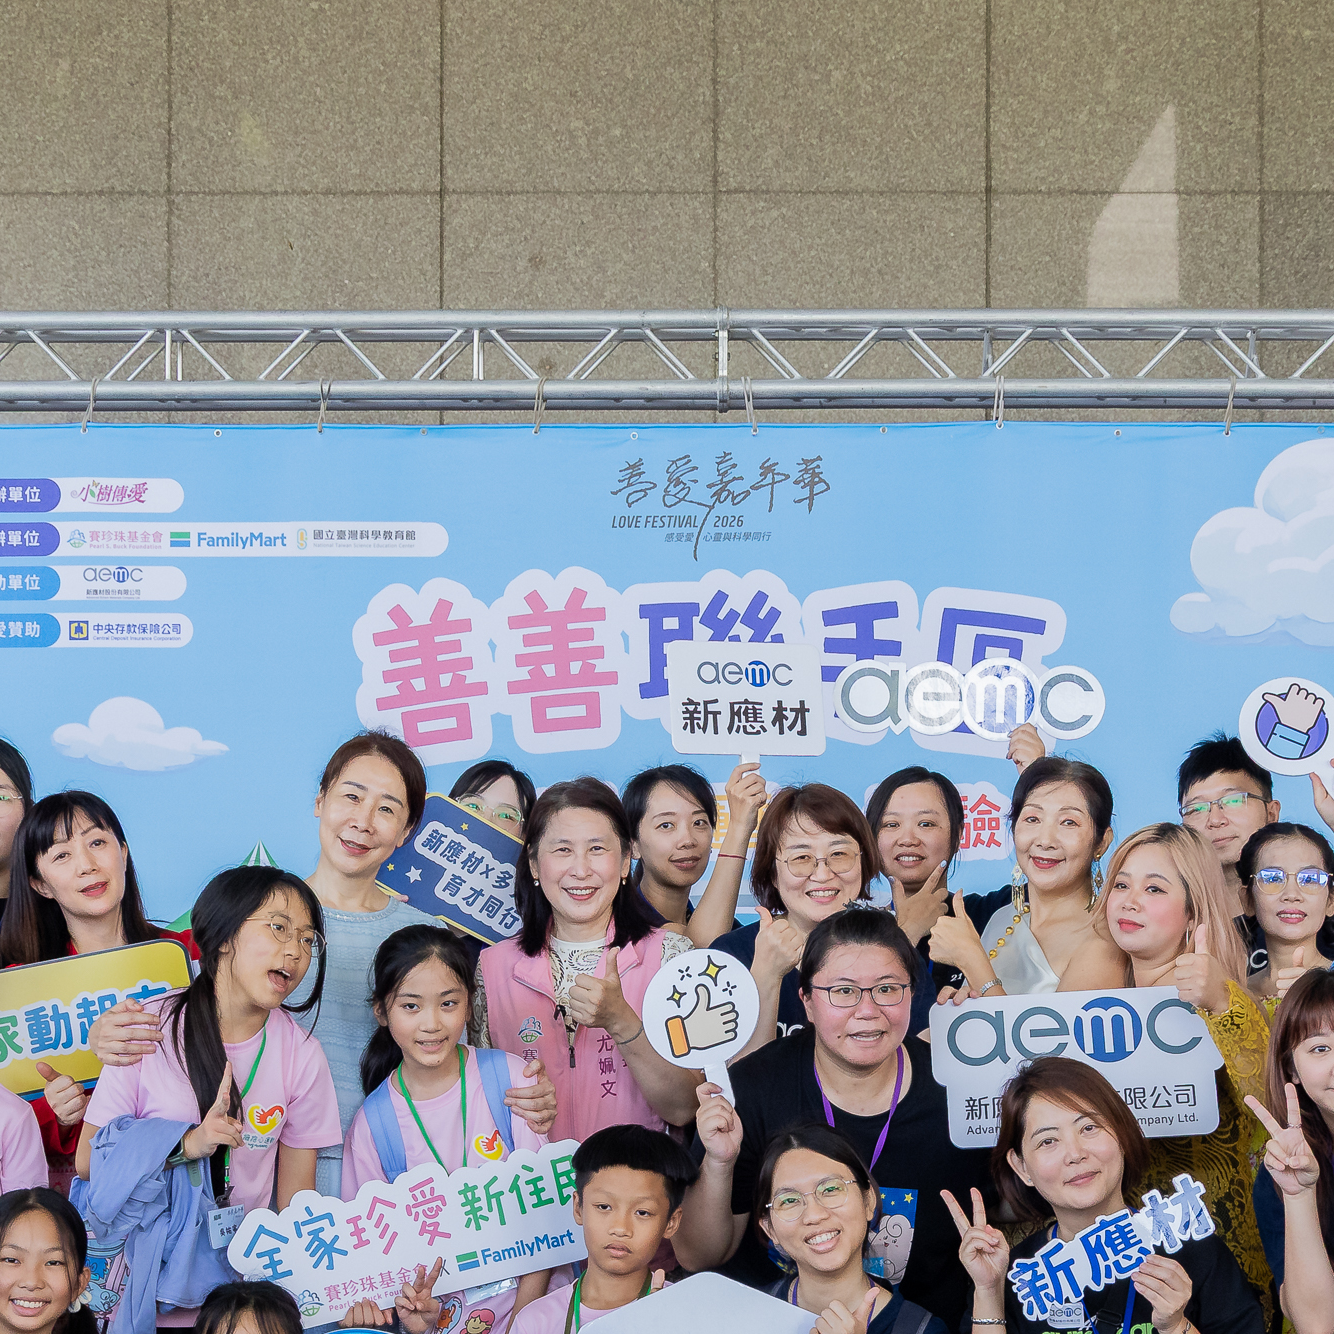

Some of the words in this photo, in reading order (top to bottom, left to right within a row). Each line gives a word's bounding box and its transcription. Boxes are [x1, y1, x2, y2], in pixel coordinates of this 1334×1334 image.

[75, 481, 149, 504] 小樹傳愛
[612, 515, 642, 529] LOVE
[644, 515, 698, 529] FESTIVAL
[713, 515, 744, 528] 2026
[89, 530, 163, 543] 賽珍珠基金會
[197, 532, 287, 549] FamilyMart
[313, 529, 417, 541] 國立臺灣科學教育館
[664, 532, 695, 543] 感受愛
[702, 532, 772, 542] 心靈與科學同行
[83, 566, 143, 583] aemc
[93, 623, 182, 635] 中央存款保險公司
[696, 659, 793, 688] aemc
[841, 662, 1095, 736] aemc
[681, 697, 811, 737] 新應材
[442, 873, 520, 930] 育才同行
[950, 973, 964, 982] 21
[947, 996, 1203, 1066] aemc
[967, 1125, 1001, 1135] Advan
[1137, 1114, 1174, 1127] mpany
[1177, 1112, 1199, 1122] Ltd.
[243, 1154, 577, 1281] 全家珍愛新住民
[481, 1232, 575, 1266] FamilyMart
[1011, 1177, 1212, 1316] 新應材
[329, 1301, 351, 1312] Pearl
